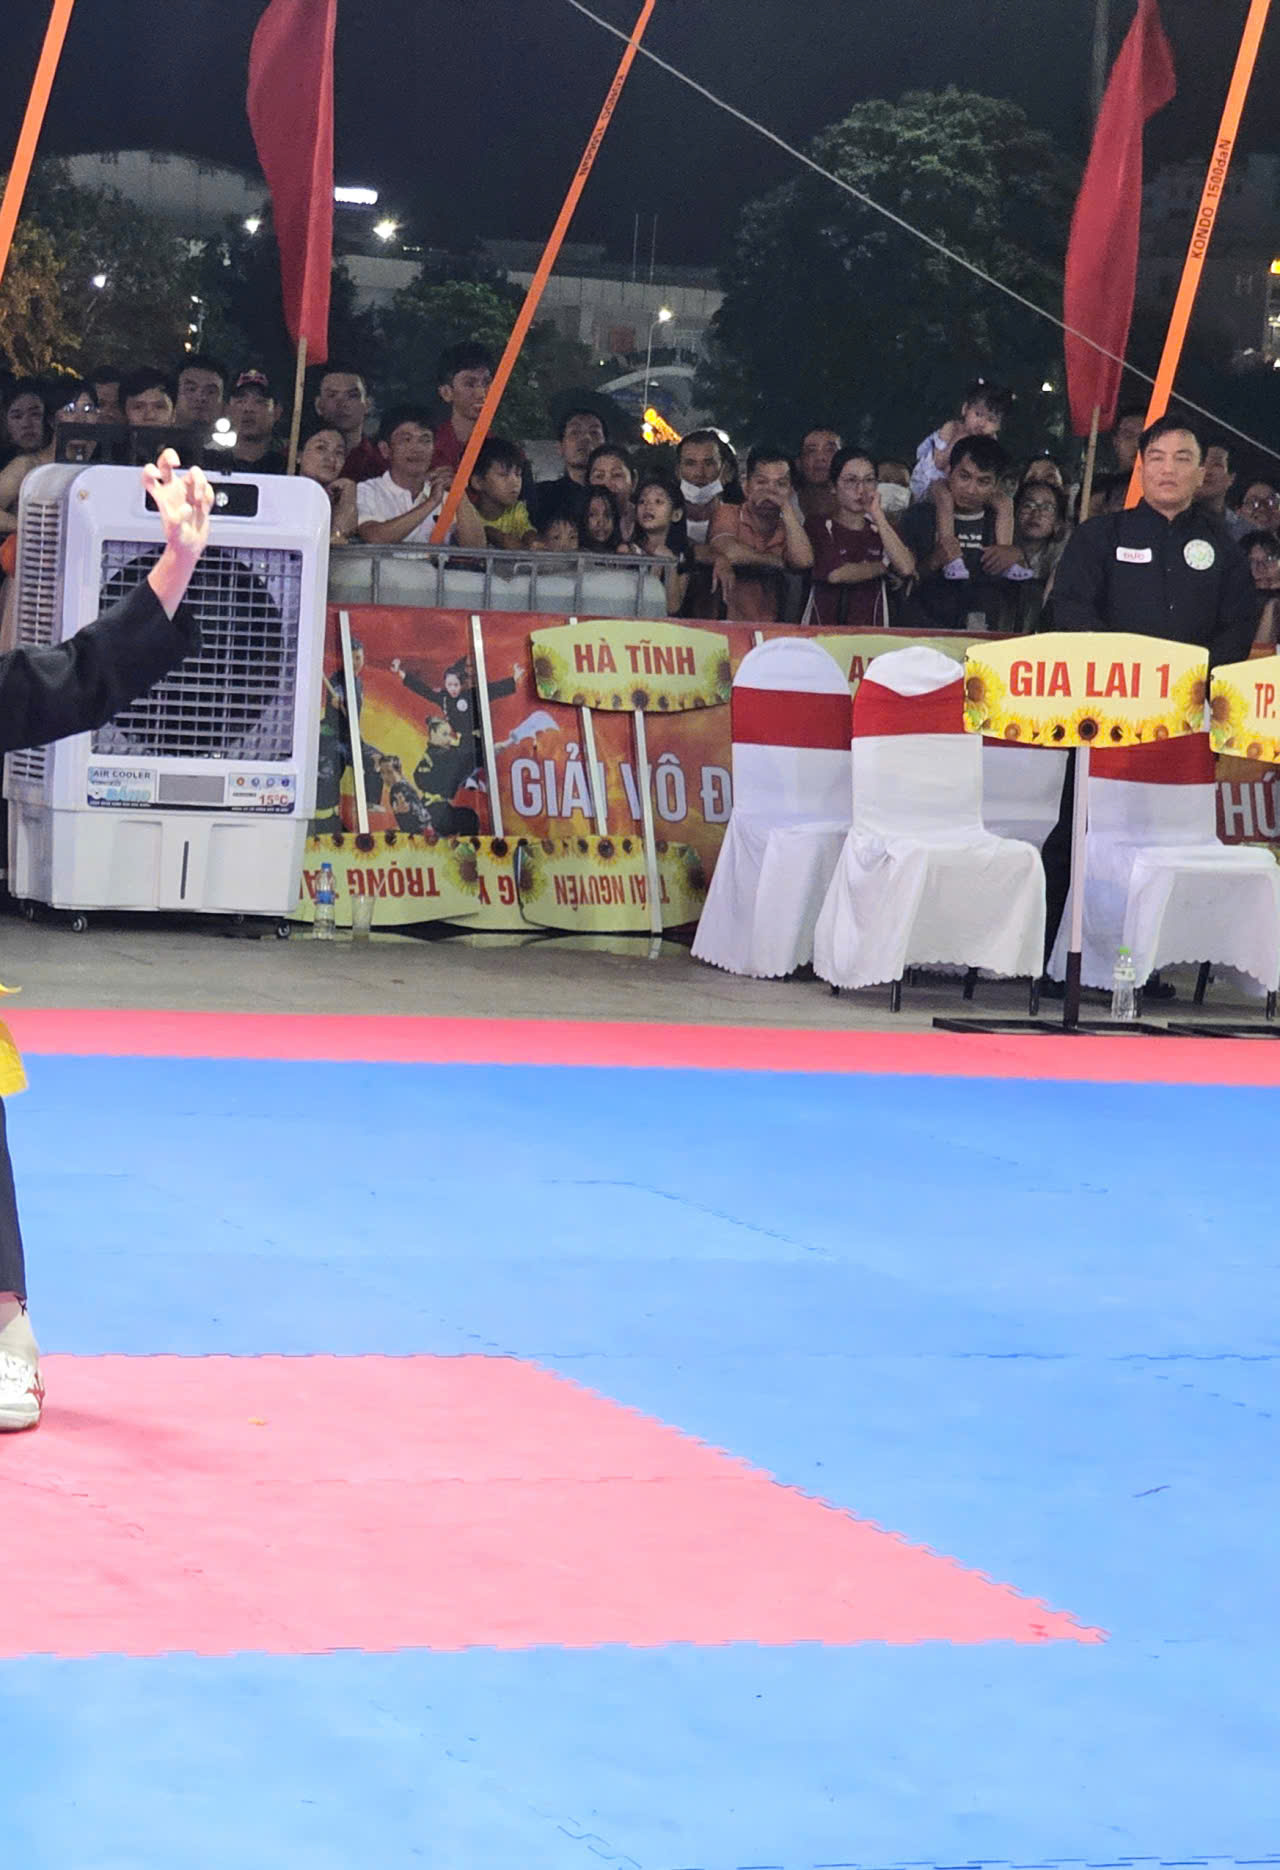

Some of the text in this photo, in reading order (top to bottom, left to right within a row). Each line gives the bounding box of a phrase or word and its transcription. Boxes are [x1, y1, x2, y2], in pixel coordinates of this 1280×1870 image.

[1190, 138, 1232, 259] KONDO 1500daN
[574, 637, 696, 676] HÀ TĨNH
[1010, 660, 1170, 698] GIA LAI 1
[1254, 683, 1277, 719] TP.
[93, 769, 151, 780] AIR COOLER
[259, 793, 289, 806] 15°C
[346, 860, 441, 899] TRỌNG
[553, 875, 671, 912] TÁI NGUYÊN
